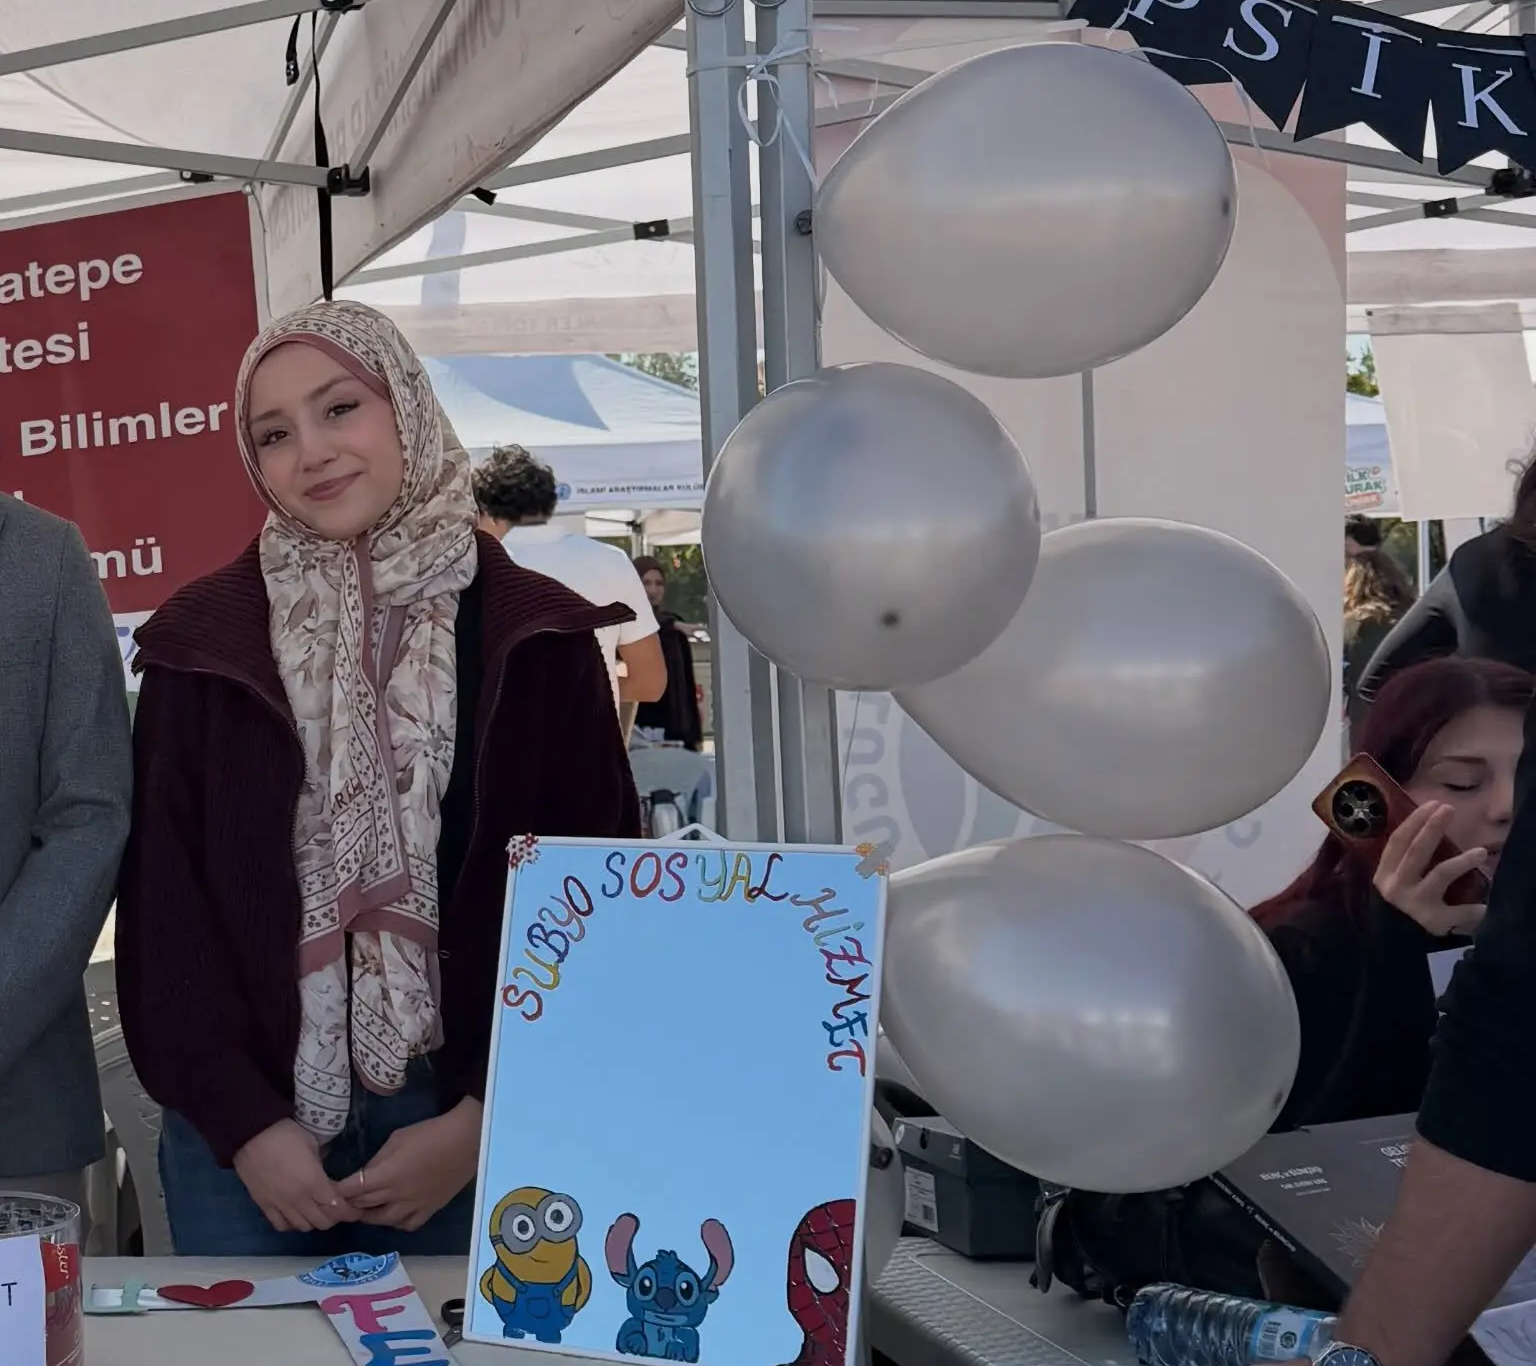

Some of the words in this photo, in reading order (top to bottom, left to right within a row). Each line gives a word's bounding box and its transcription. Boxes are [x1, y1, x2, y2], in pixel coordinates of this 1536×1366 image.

[20, 402, 228, 457] Bilimler
[601, 850, 790, 902] SOSYAL
[790, 887, 874, 1077] HİZMET
